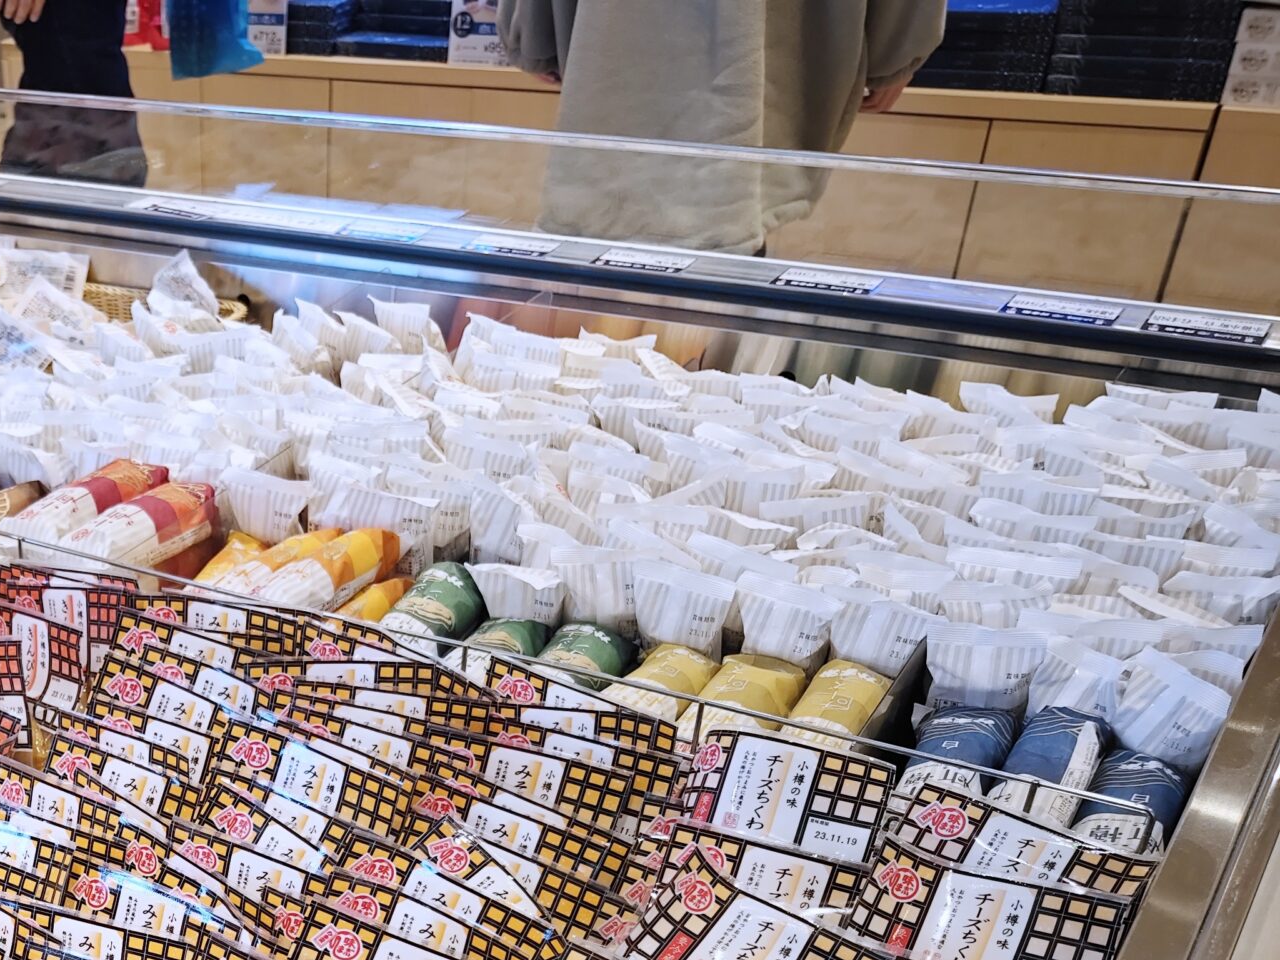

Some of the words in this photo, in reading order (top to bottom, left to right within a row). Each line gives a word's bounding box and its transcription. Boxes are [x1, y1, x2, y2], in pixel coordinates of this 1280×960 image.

[746, 754, 784, 830] チーズちくわ
[786, 761, 809, 810] 小樽の味
[814, 830, 857, 846] 23.11.19
[996, 900, 1023, 950] 小樽の味
